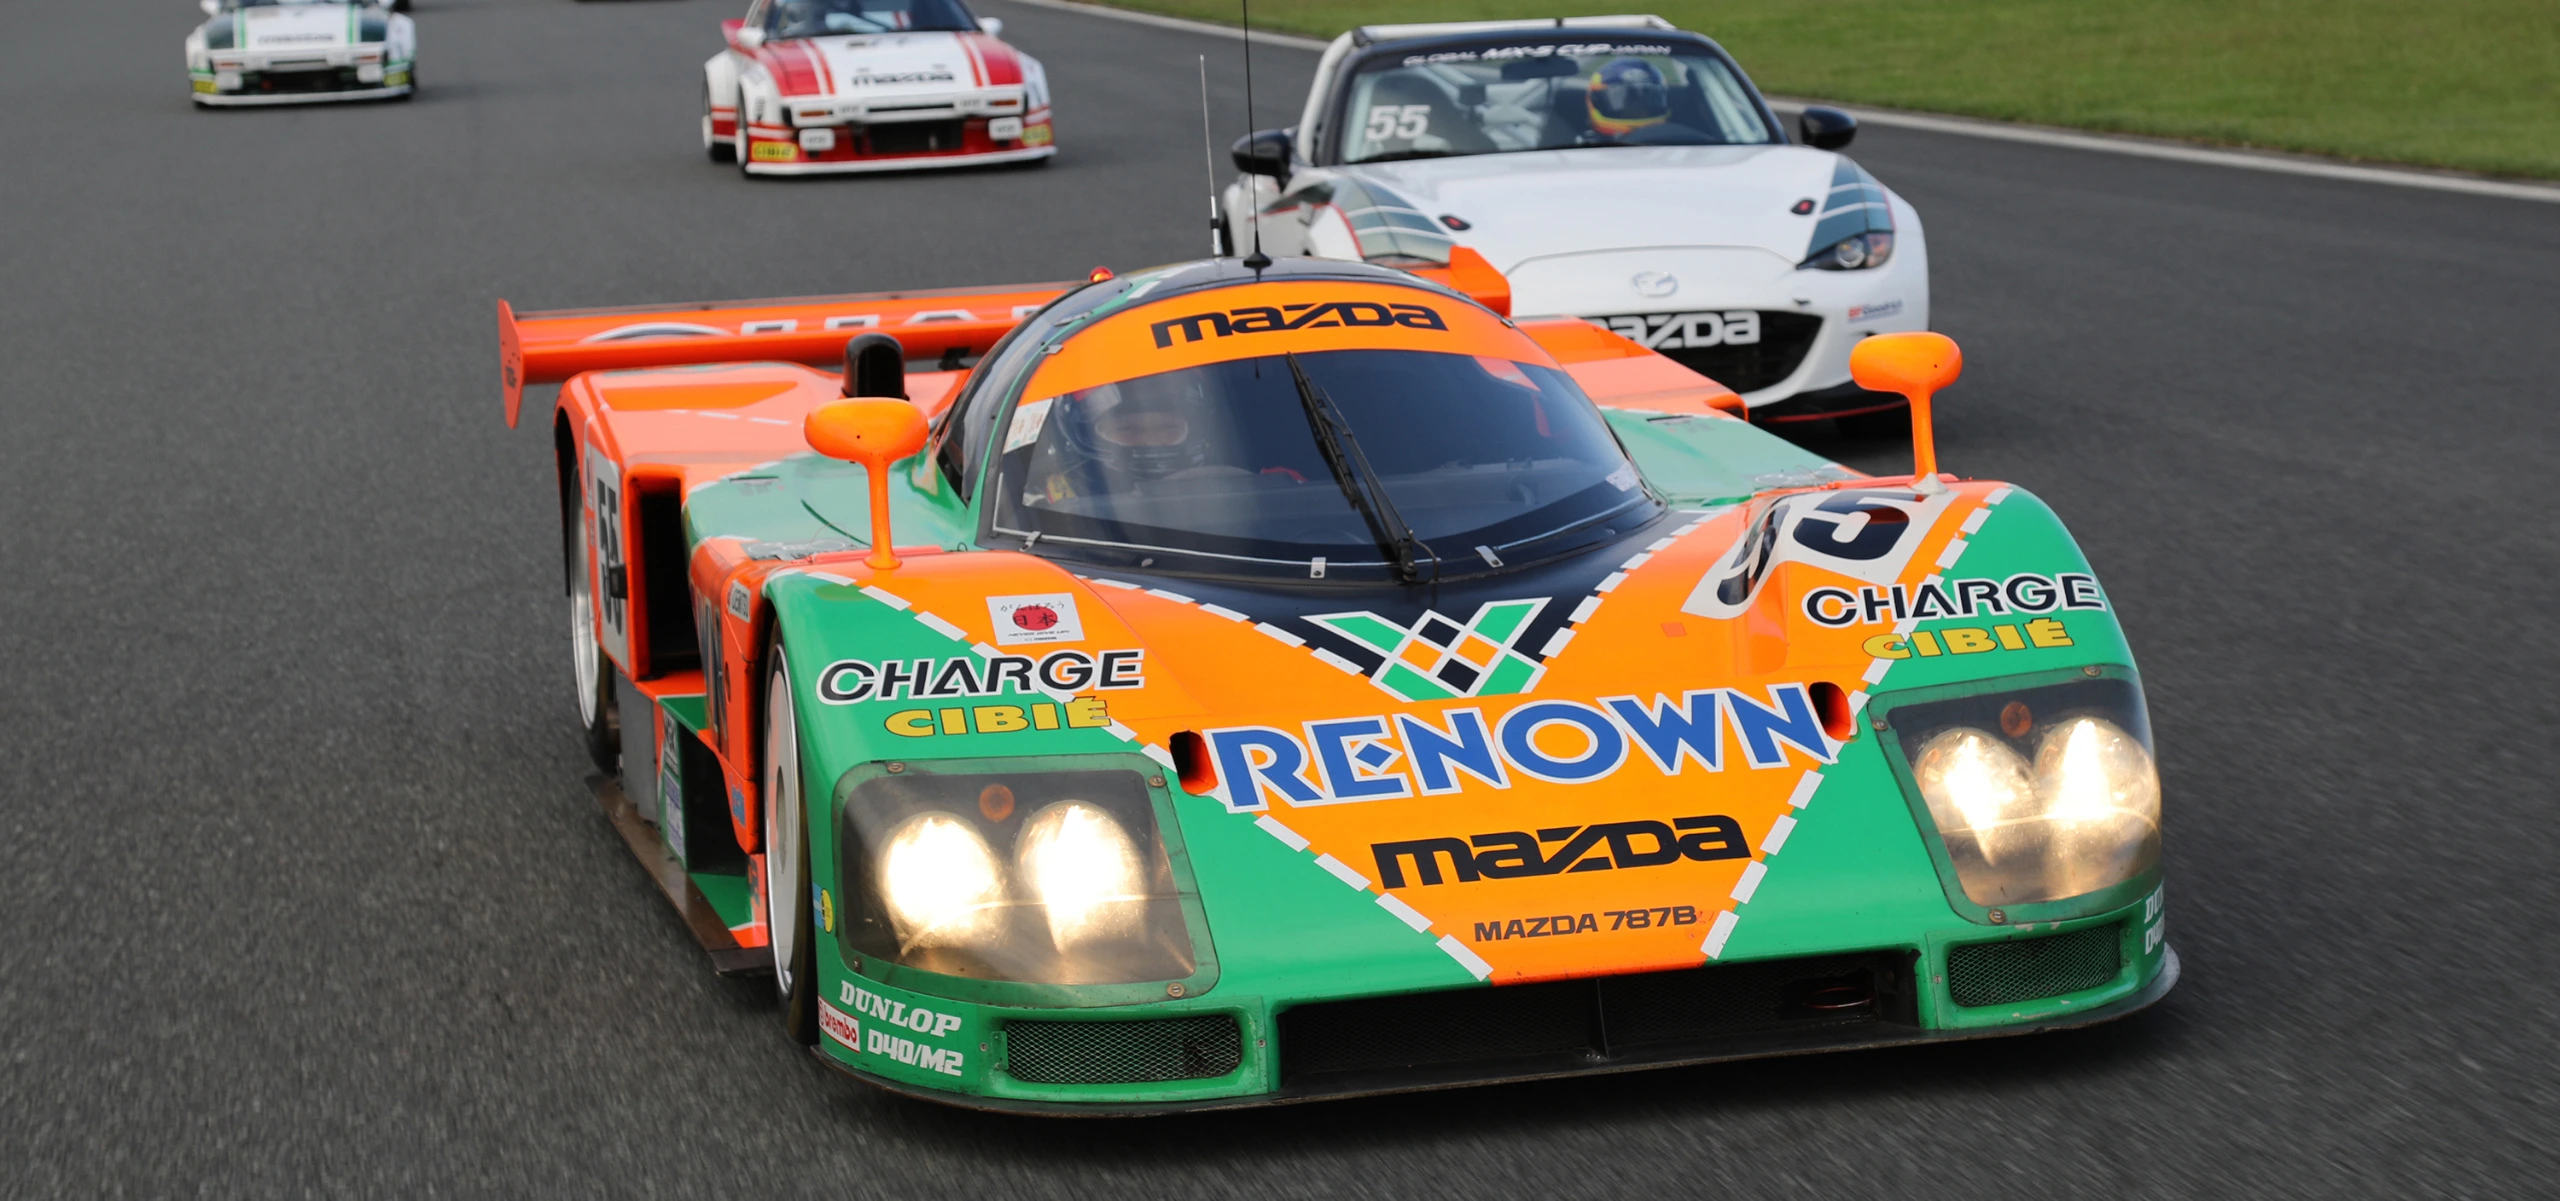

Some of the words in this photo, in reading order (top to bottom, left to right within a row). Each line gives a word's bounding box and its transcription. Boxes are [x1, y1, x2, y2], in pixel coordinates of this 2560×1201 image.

[1403, 51, 1478, 67] GLOBAL
[1481, 44, 1556, 60] MX-5
[1556, 43, 1612, 56] CUP
[1611, 44, 1671, 56] JAPAN
[1366, 105, 1430, 140] 55
[1597, 310, 1760, 349] azda
[1013, 613, 1060, 627] 日本
[1801, 572, 2107, 628] CHARGE
[1862, 617, 2075, 660] CIBIÉ
[815, 648, 1145, 705] CHARGE
[884, 696, 1113, 737] CIBIÉ
[1202, 682, 1839, 814] RENOWN
[1474, 912, 1599, 942] MAZDA
[1603, 905, 1698, 931] 787B
[824, 1004, 857, 1044] brembo
[839, 979, 962, 1038] DUNLOP
[867, 1028, 964, 1077] D40/M2
